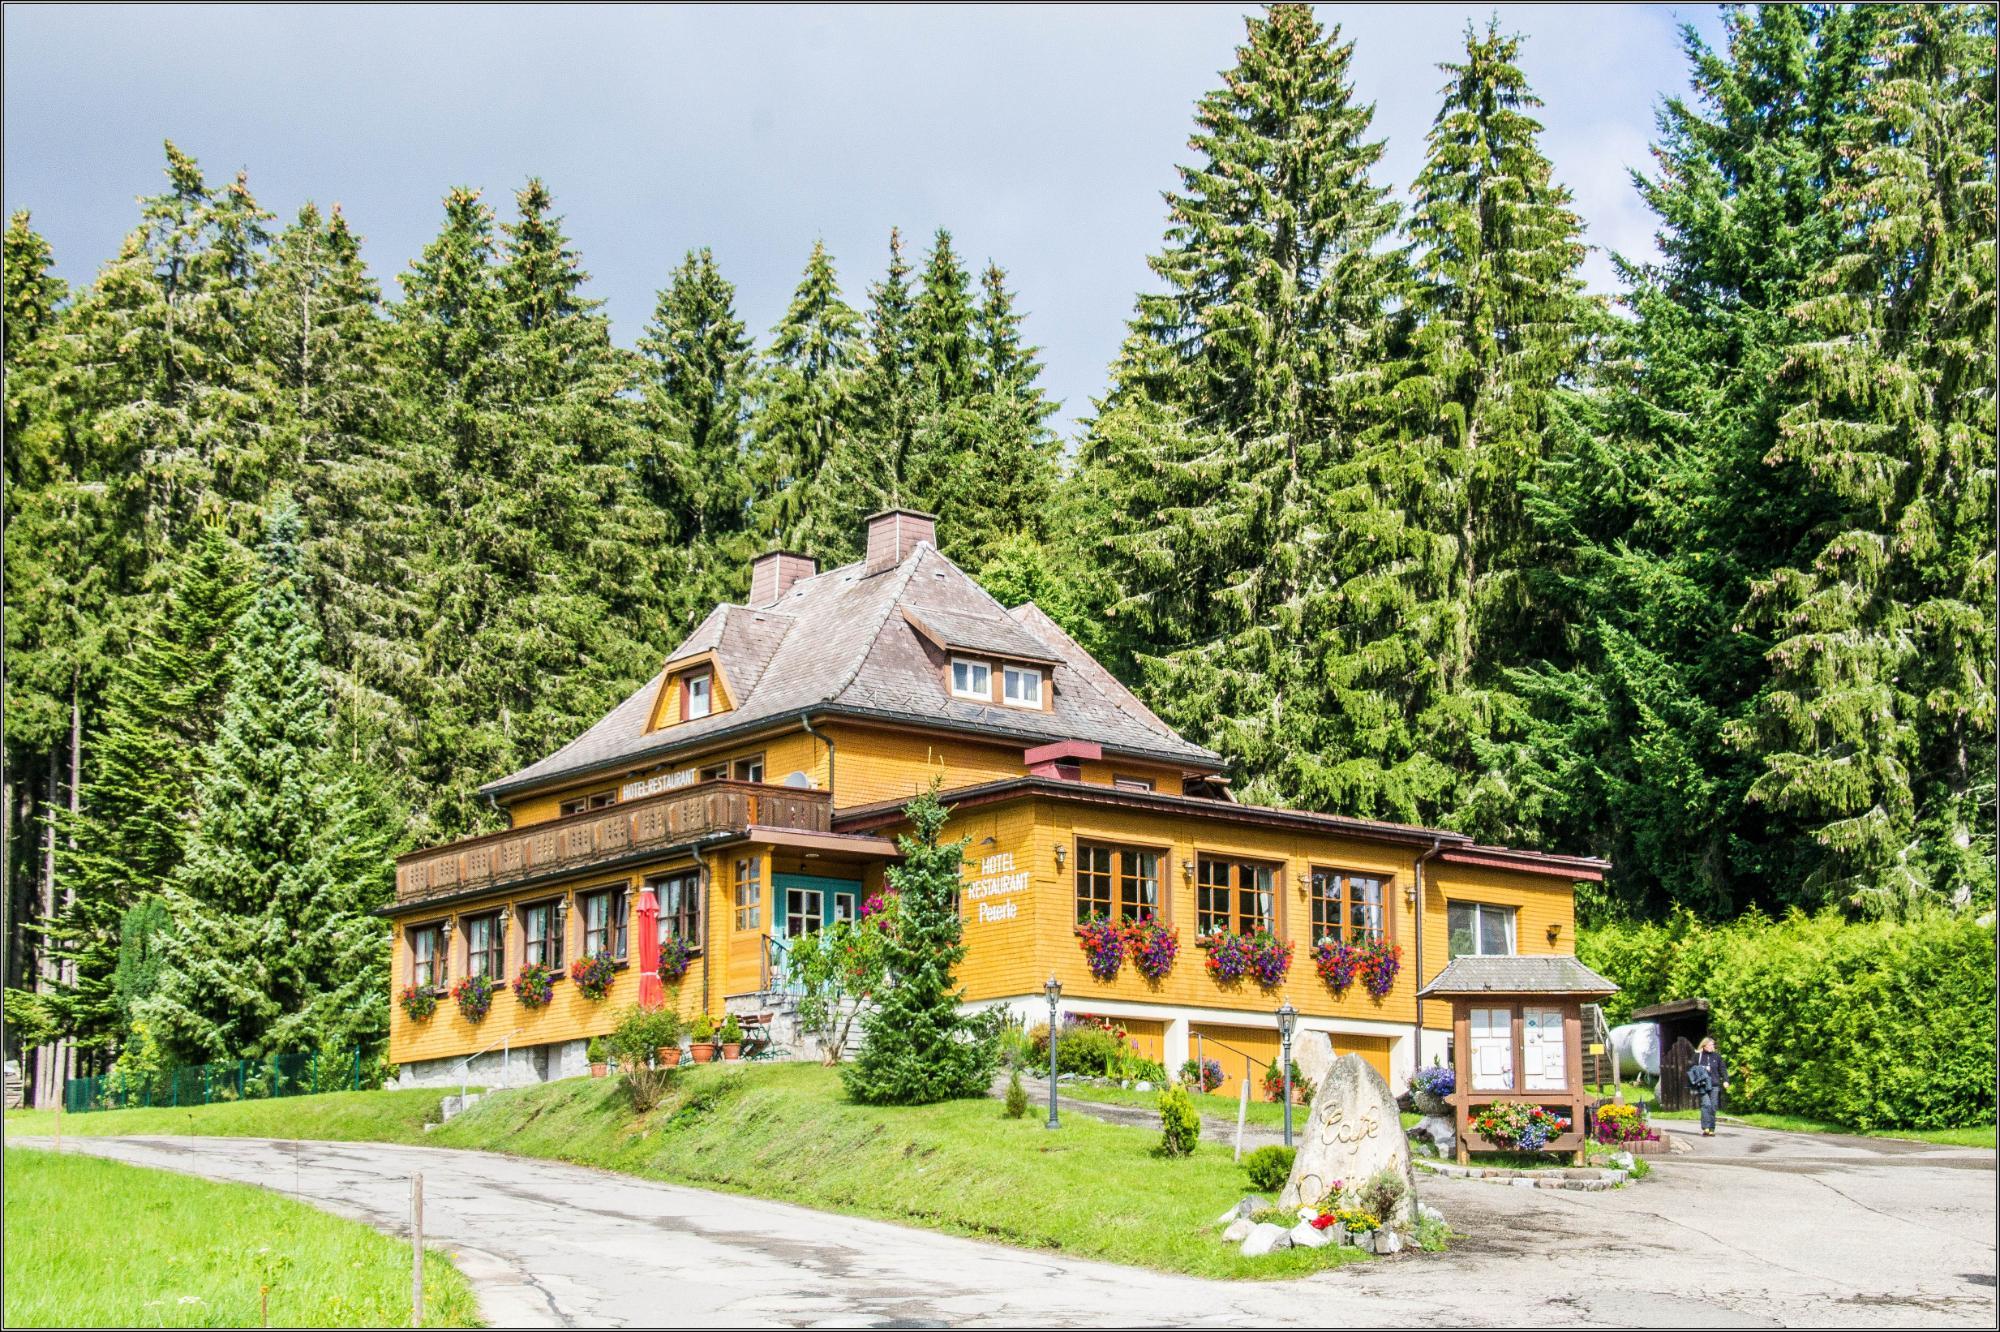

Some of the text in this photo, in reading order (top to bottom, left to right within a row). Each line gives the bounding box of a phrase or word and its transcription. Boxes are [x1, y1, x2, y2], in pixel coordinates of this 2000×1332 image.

[981, 852, 1016, 875] HOTEL
[968, 872, 1029, 900] RESTAURANT
[979, 898, 1017, 923] Peterle
